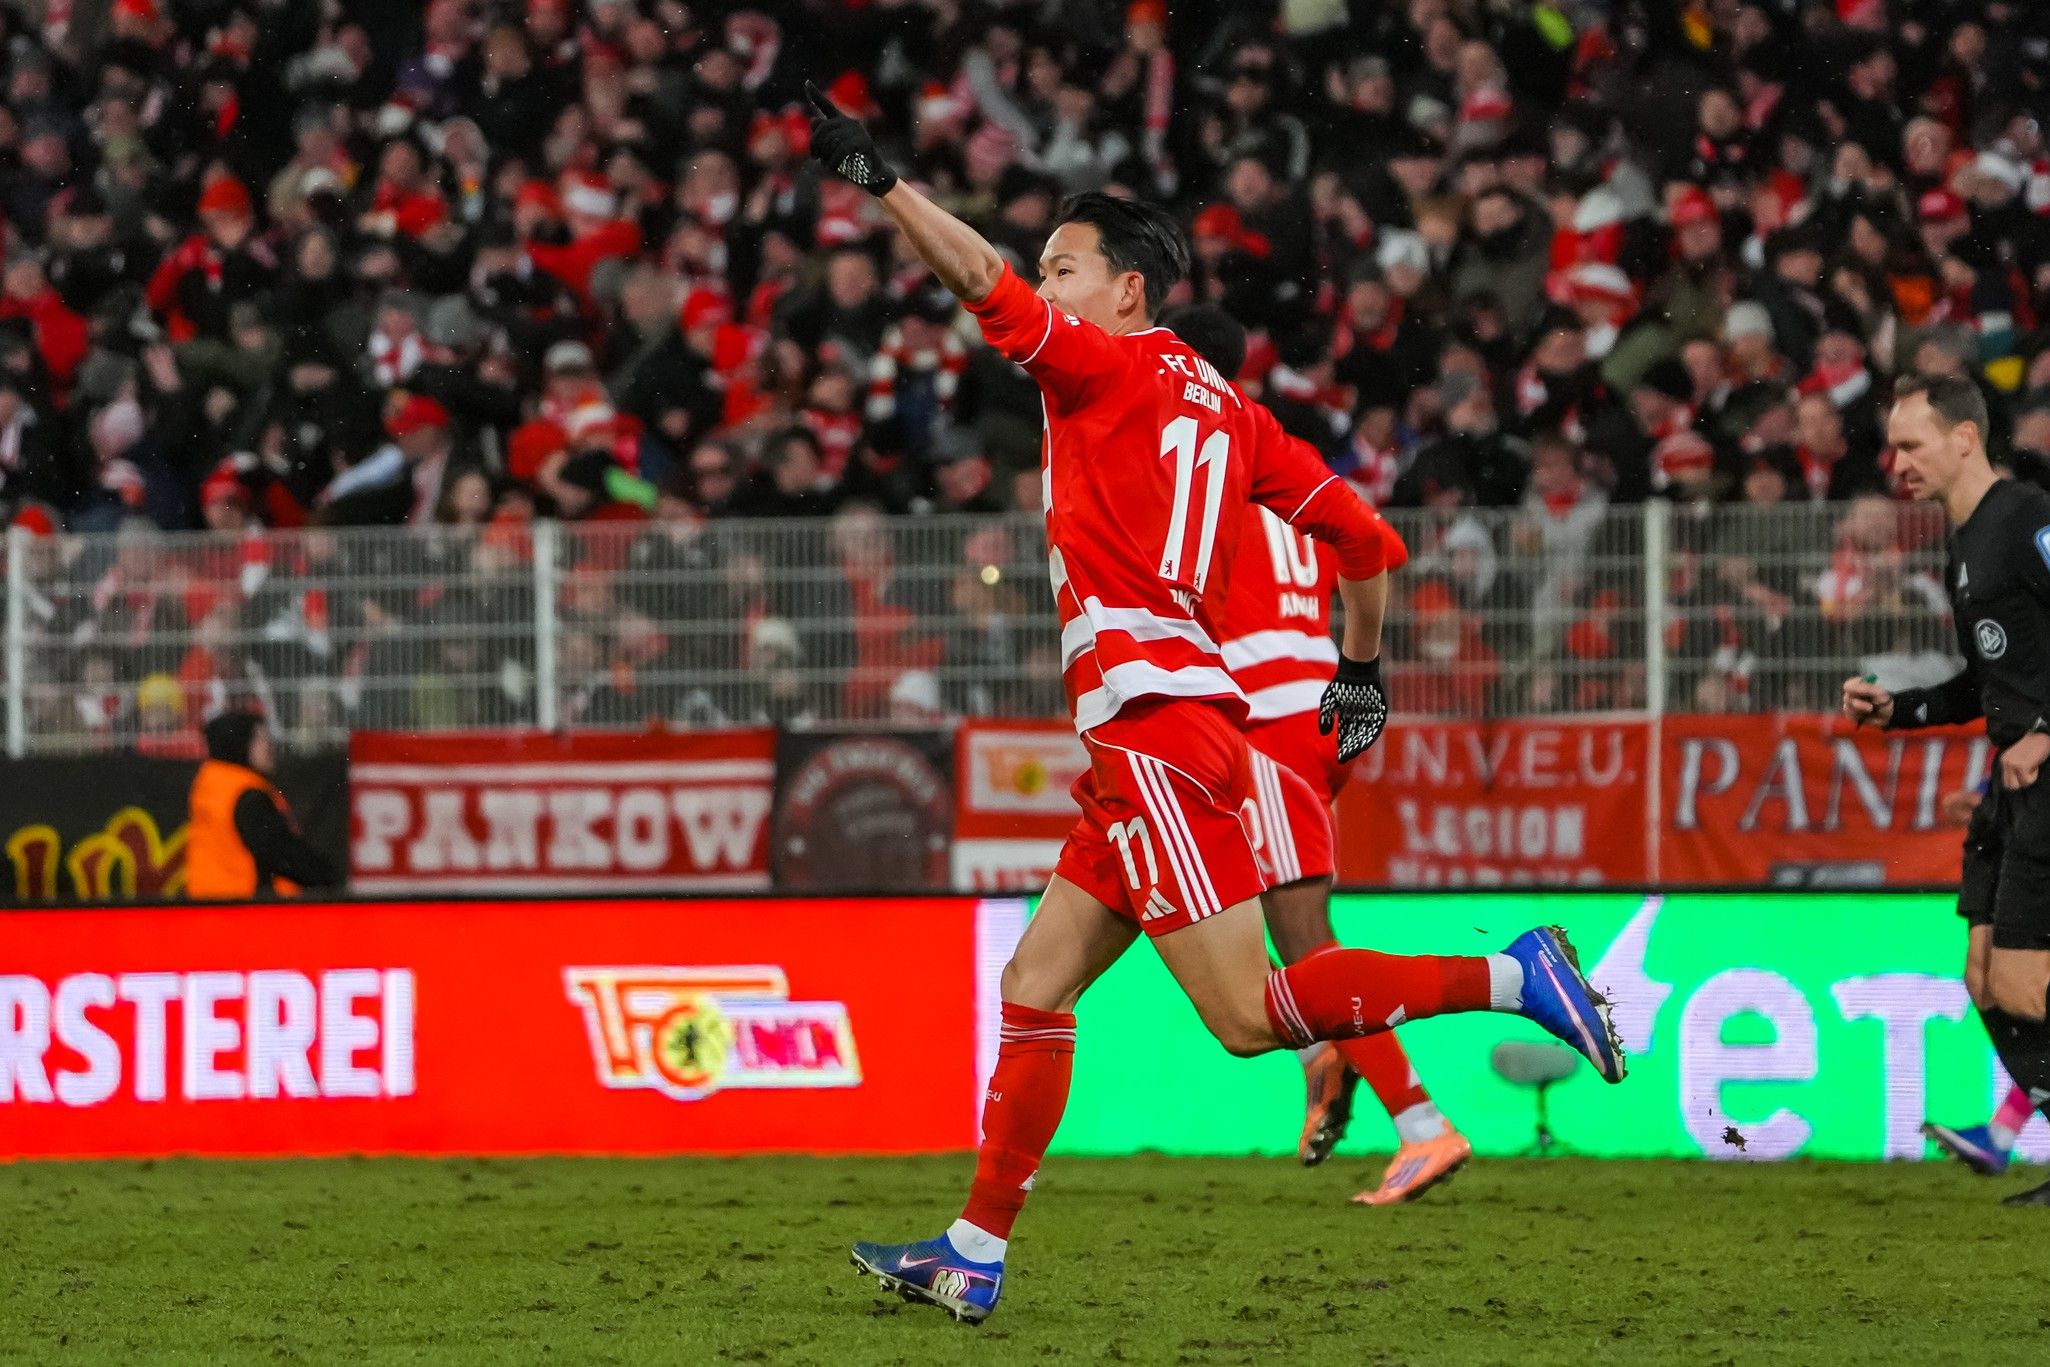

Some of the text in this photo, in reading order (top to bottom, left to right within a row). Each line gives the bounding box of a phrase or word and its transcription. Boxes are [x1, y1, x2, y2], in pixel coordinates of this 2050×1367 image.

[1183, 380, 1221, 415] BERLIN
[1159, 415, 1230, 595] 11
[353, 787, 773, 870] PANKOW
[1107, 815, 1159, 890] 11
[1398, 799, 1585, 858] LEGION
[0, 967, 417, 1108] RSTEREI
